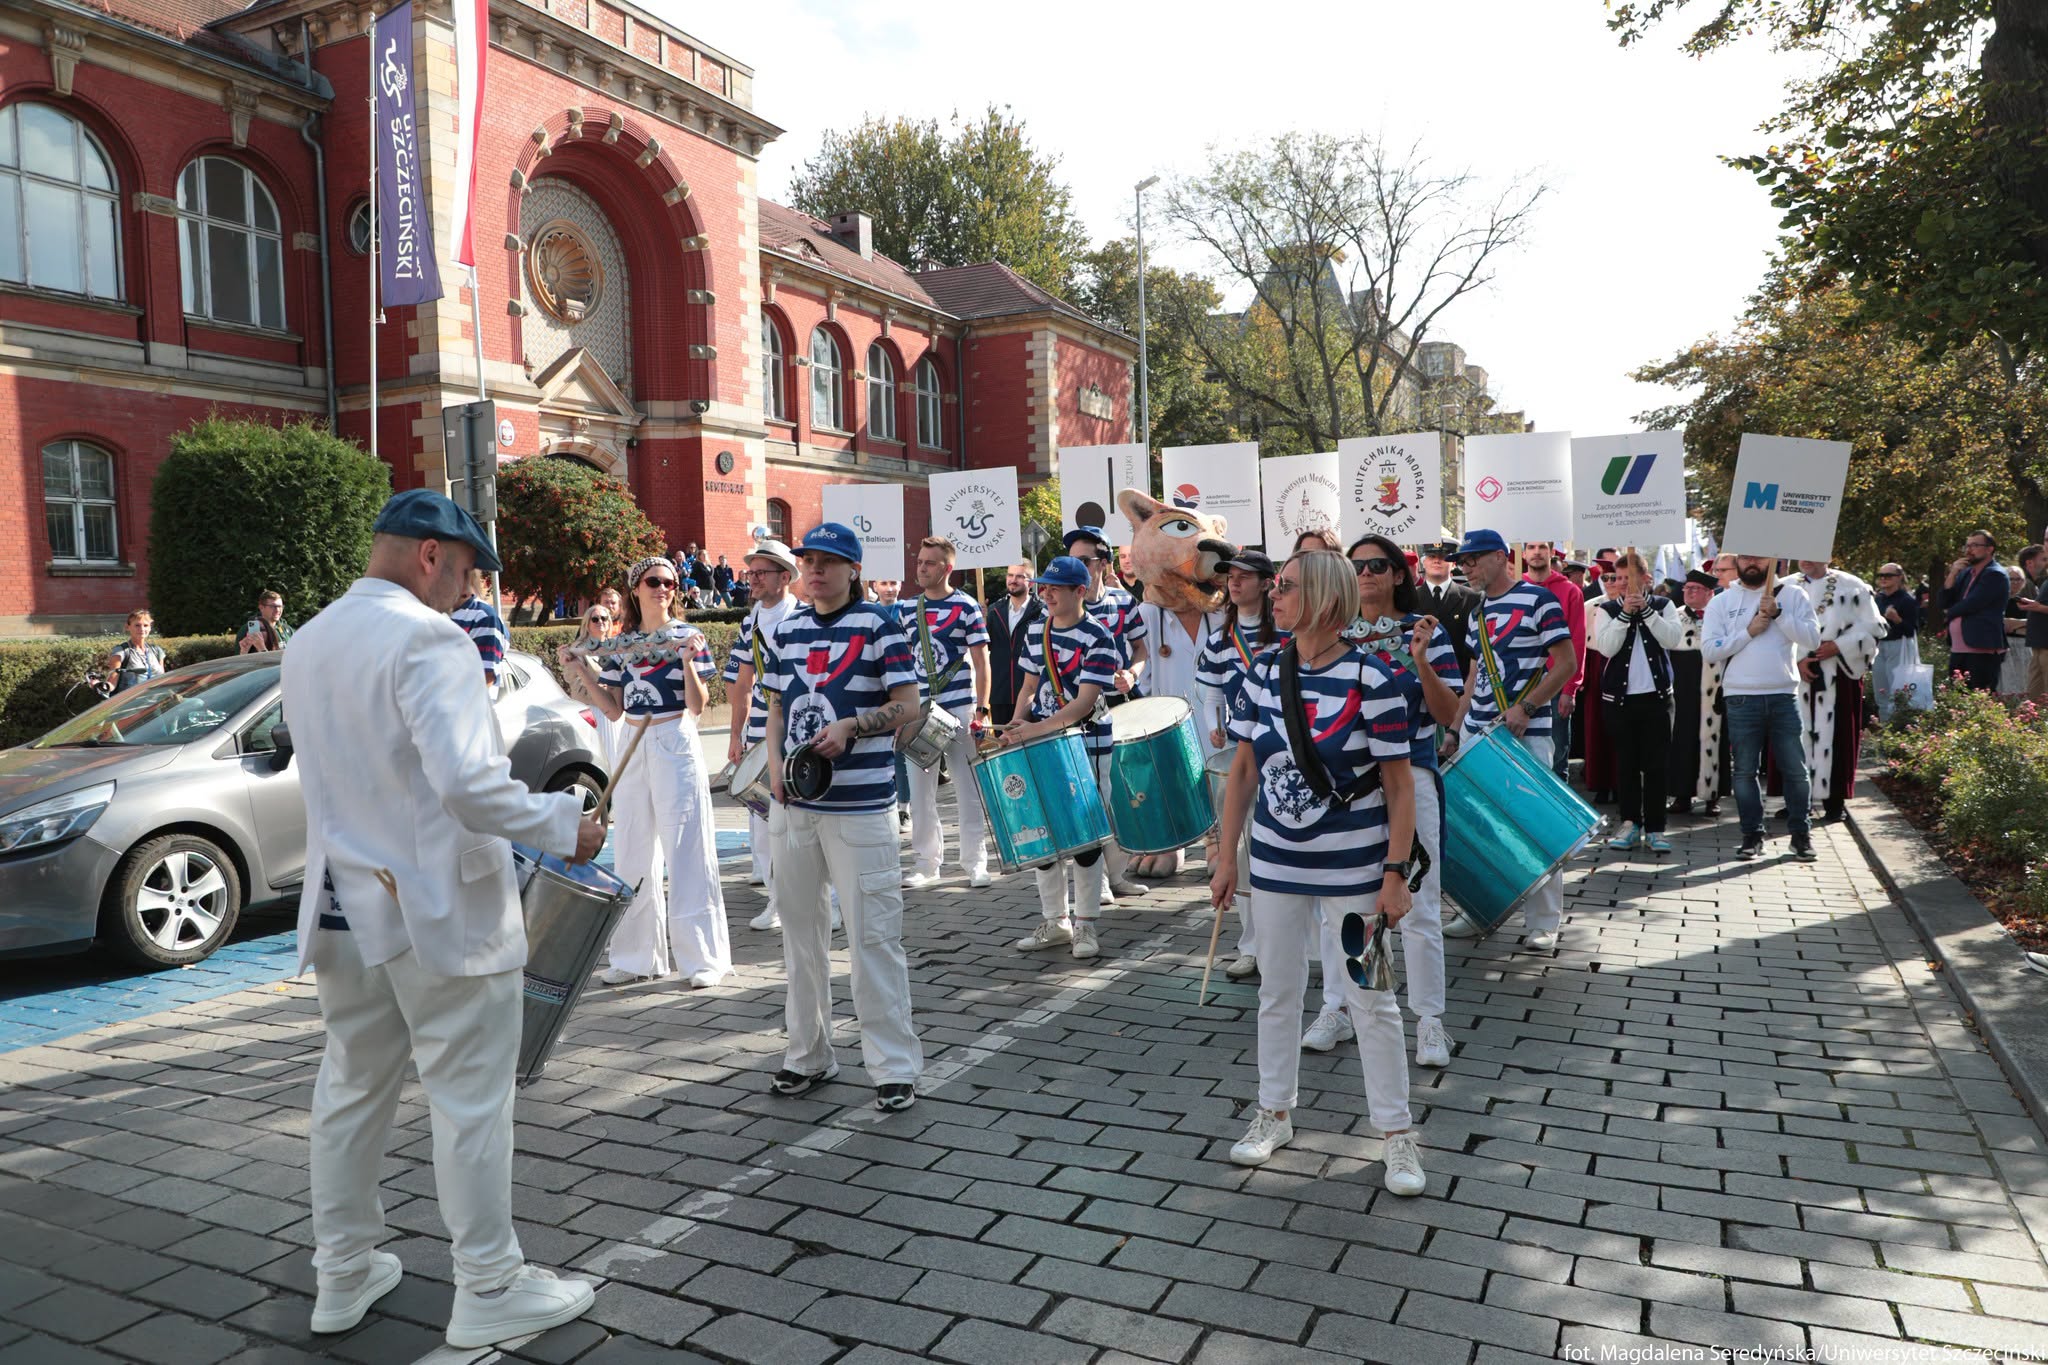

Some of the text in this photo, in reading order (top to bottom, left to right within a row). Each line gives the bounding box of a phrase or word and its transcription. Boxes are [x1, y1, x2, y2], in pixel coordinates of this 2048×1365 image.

[391, 117, 413, 279] SZCZECIŃSKI
[1125, 455, 1134, 486] SZTUKI
[1355, 446, 1424, 502] POLITECHNIKA MORSKA
[944, 485, 1005, 512] UNIWERSYTET
[1596, 501, 1662, 510] Zachodniopomorski
[1783, 492, 1831, 501] UNIWERSYTET
[1582, 508, 1676, 519] Uniwersytet Technologiczny
[1780, 506, 1814, 514] SZCZECIN
[1365, 515, 1415, 536] SZCZECIN
